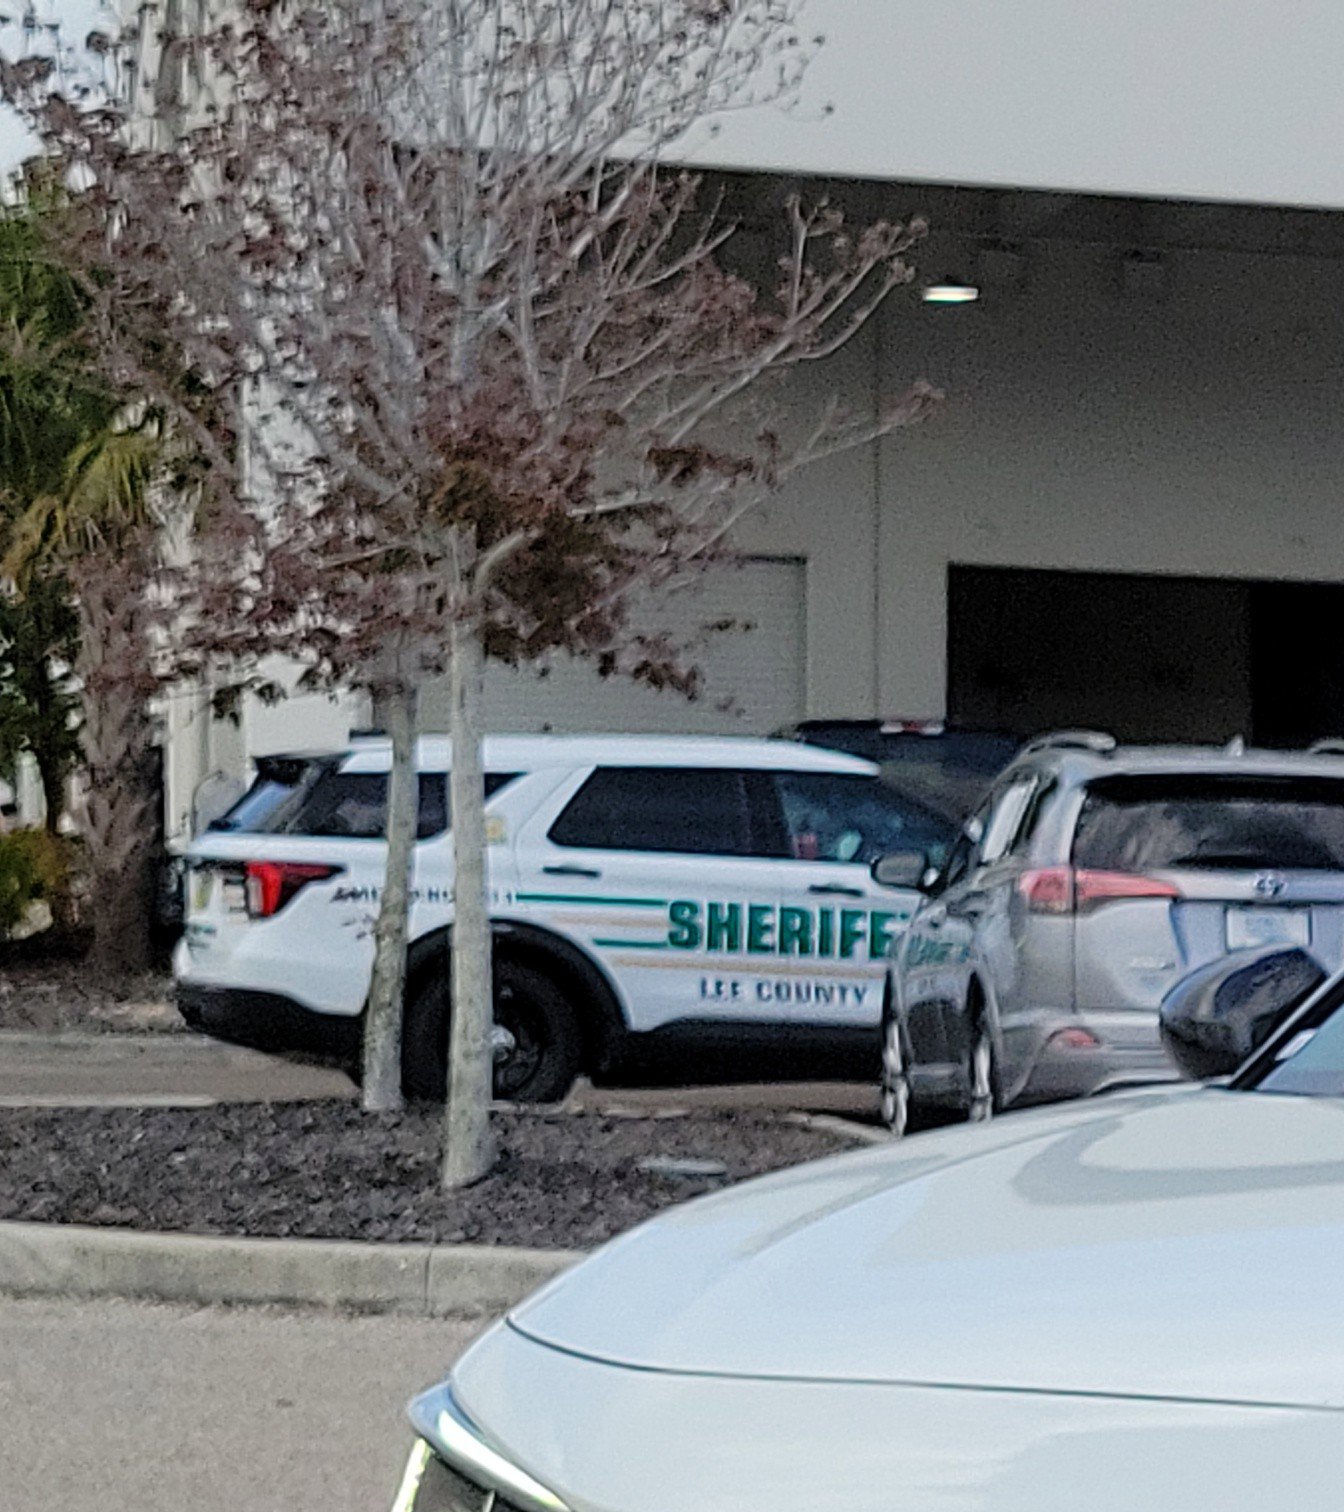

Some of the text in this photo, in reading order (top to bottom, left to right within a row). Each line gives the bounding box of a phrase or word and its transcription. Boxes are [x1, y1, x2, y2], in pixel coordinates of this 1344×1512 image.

[668, 900, 893, 959] SHERIFF
[701, 977, 867, 1006] LEE COUNTY
